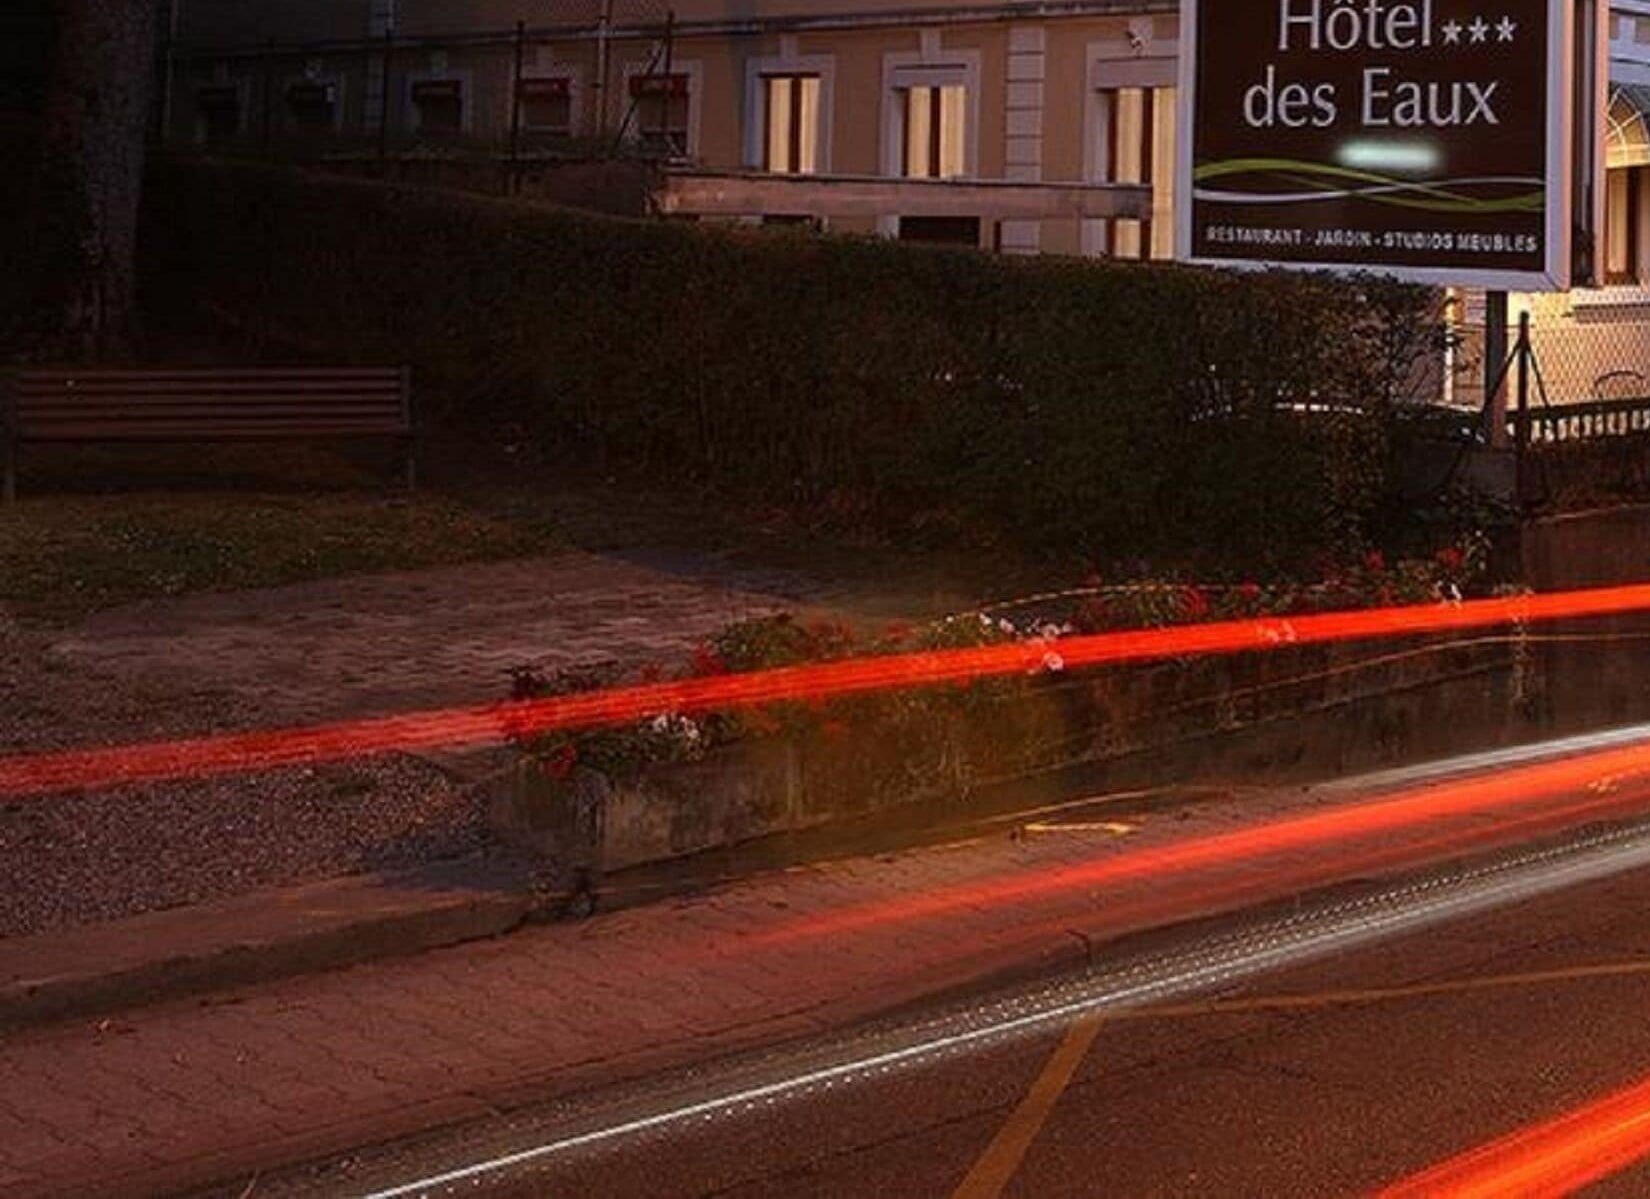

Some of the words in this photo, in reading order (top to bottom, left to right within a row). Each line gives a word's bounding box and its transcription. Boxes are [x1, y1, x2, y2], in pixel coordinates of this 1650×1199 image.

[1243, 65, 1336, 128] des
[1362, 68, 1499, 126] Eaux
[1206, 225, 1302, 245] RESTAURANT
[1315, 229, 1372, 247] JARDIN
[1383, 231, 1453, 250] STUDIOS
